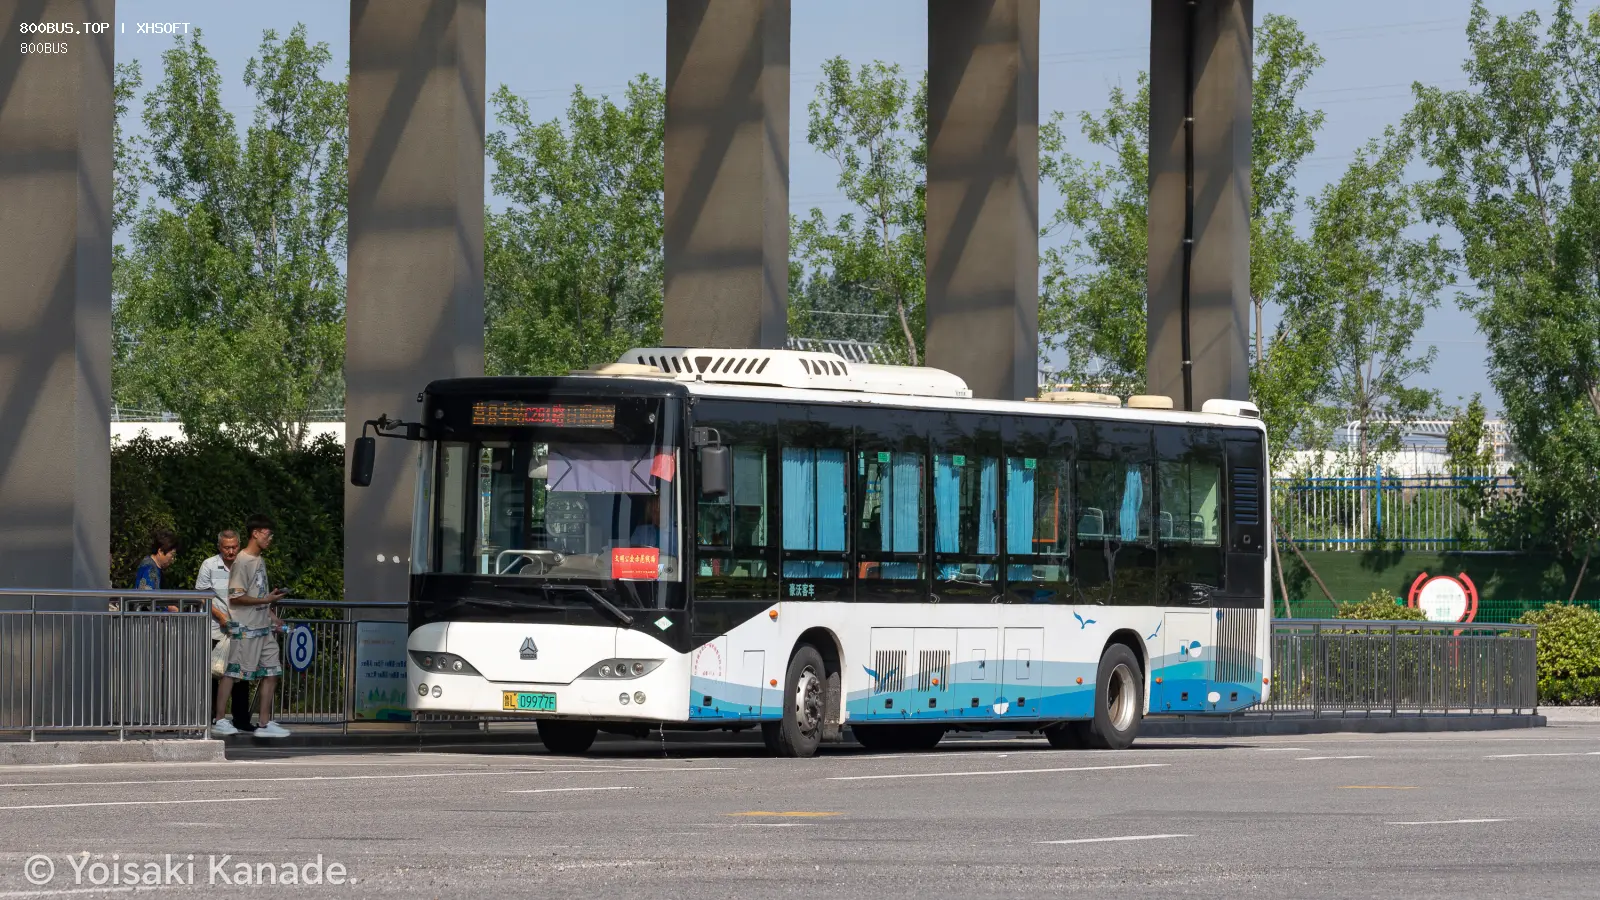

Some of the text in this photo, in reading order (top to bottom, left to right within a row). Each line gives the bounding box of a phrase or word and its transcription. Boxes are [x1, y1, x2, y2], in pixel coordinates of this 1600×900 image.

[789, 583, 815, 597] 豪沃客车
[295, 631, 308, 663] 8
